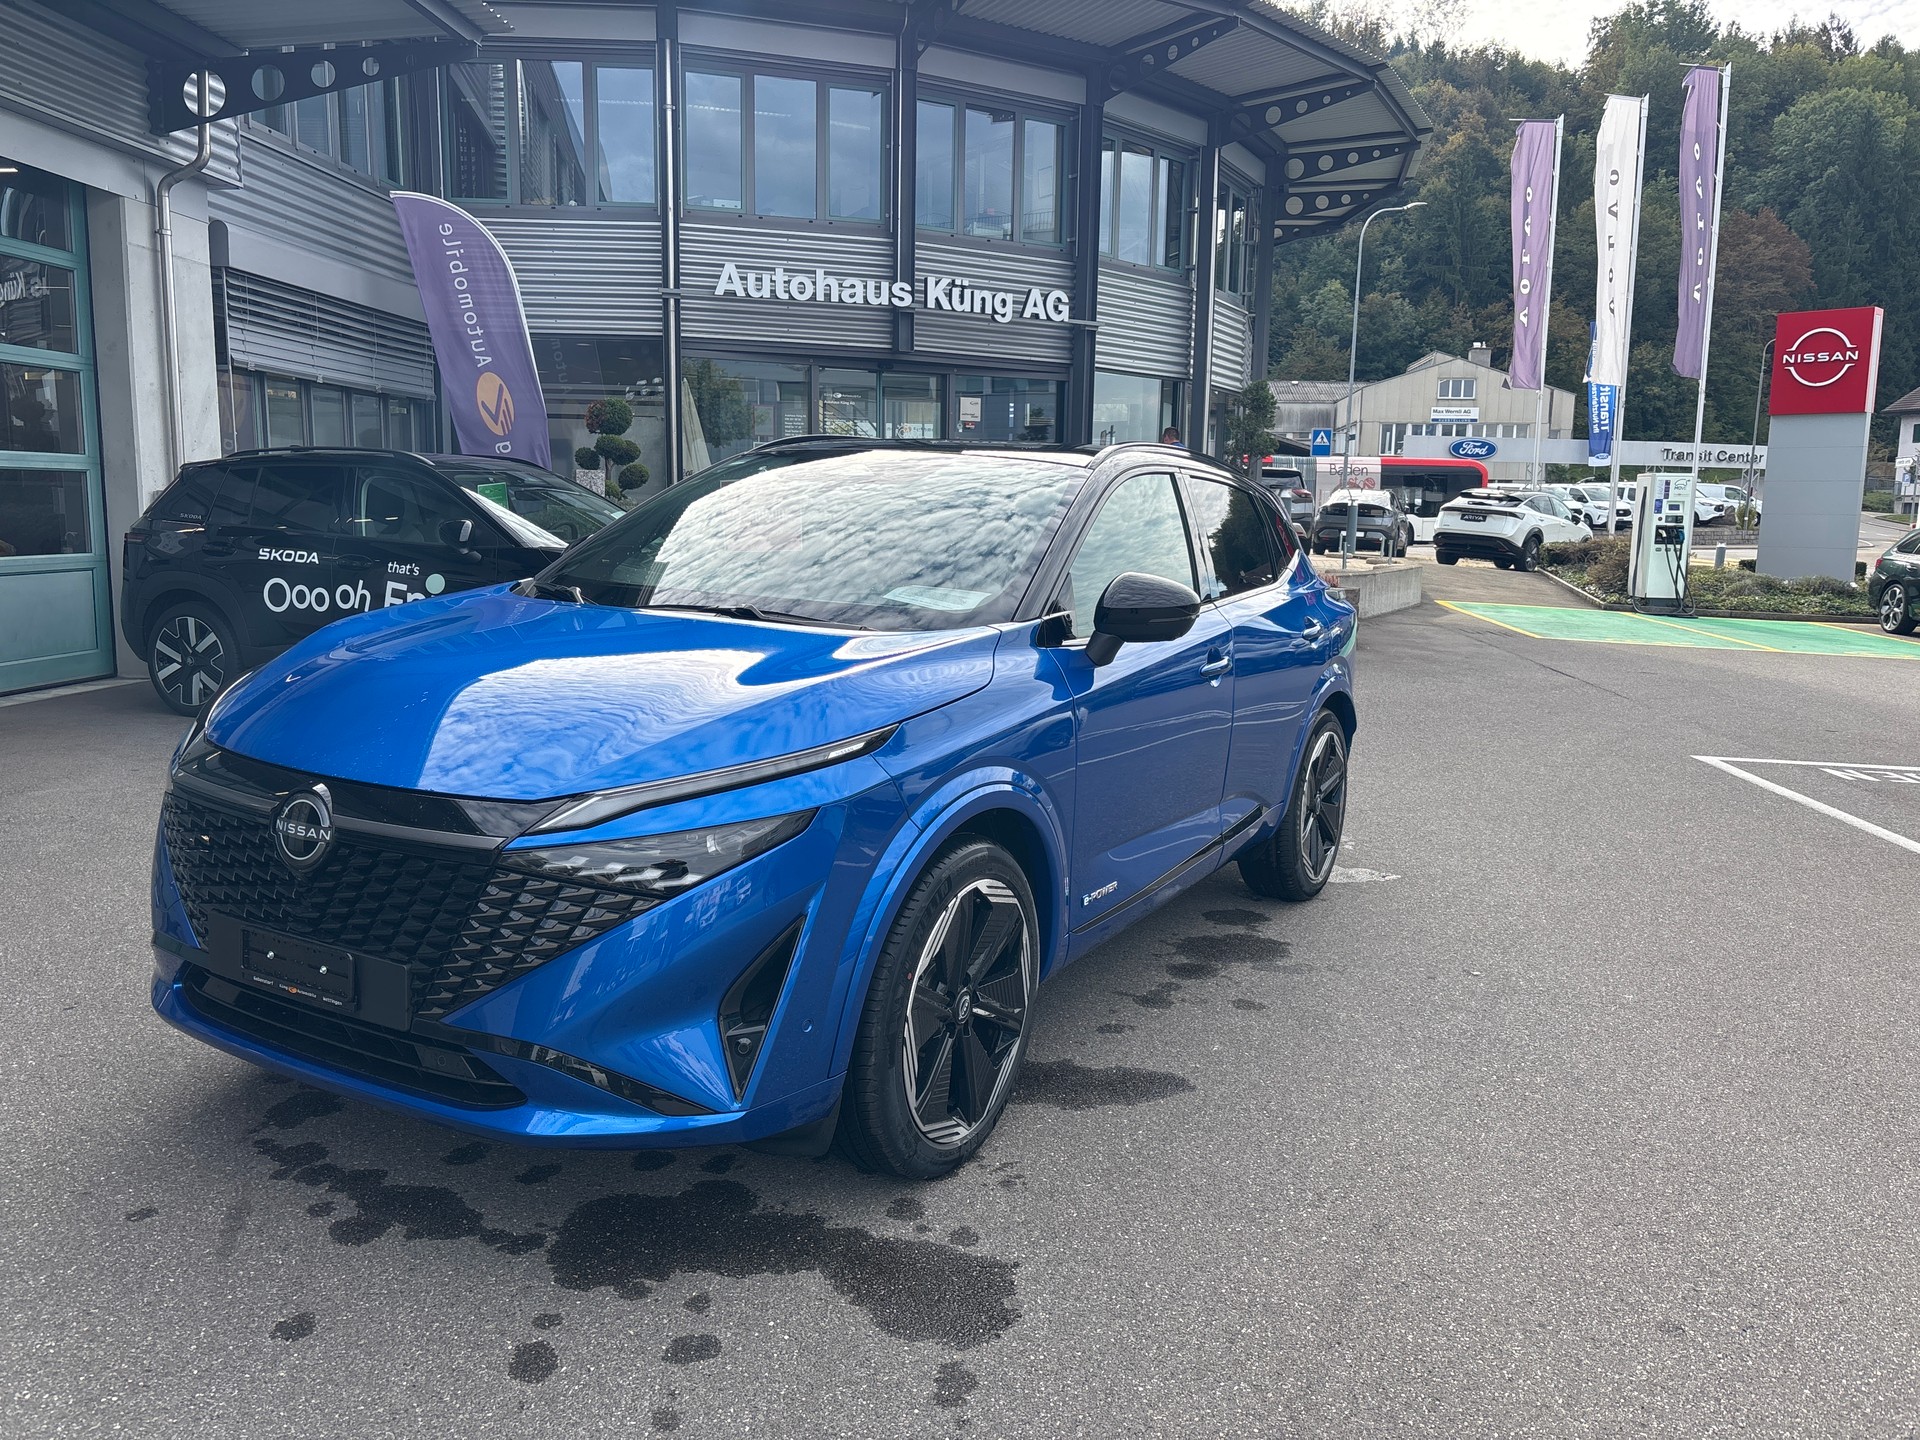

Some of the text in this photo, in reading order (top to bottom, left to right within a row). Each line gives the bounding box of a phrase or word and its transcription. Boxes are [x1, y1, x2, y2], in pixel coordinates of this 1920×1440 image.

[714, 262, 1070, 323] Autohaus Küng AG
[1782, 350, 1859, 364] NISSAN
[1460, 442, 1487, 455] Ford
[1663, 448, 1764, 463] Transit Center
[387, 561, 420, 576] that's
[276, 819, 331, 841] NISSAN
